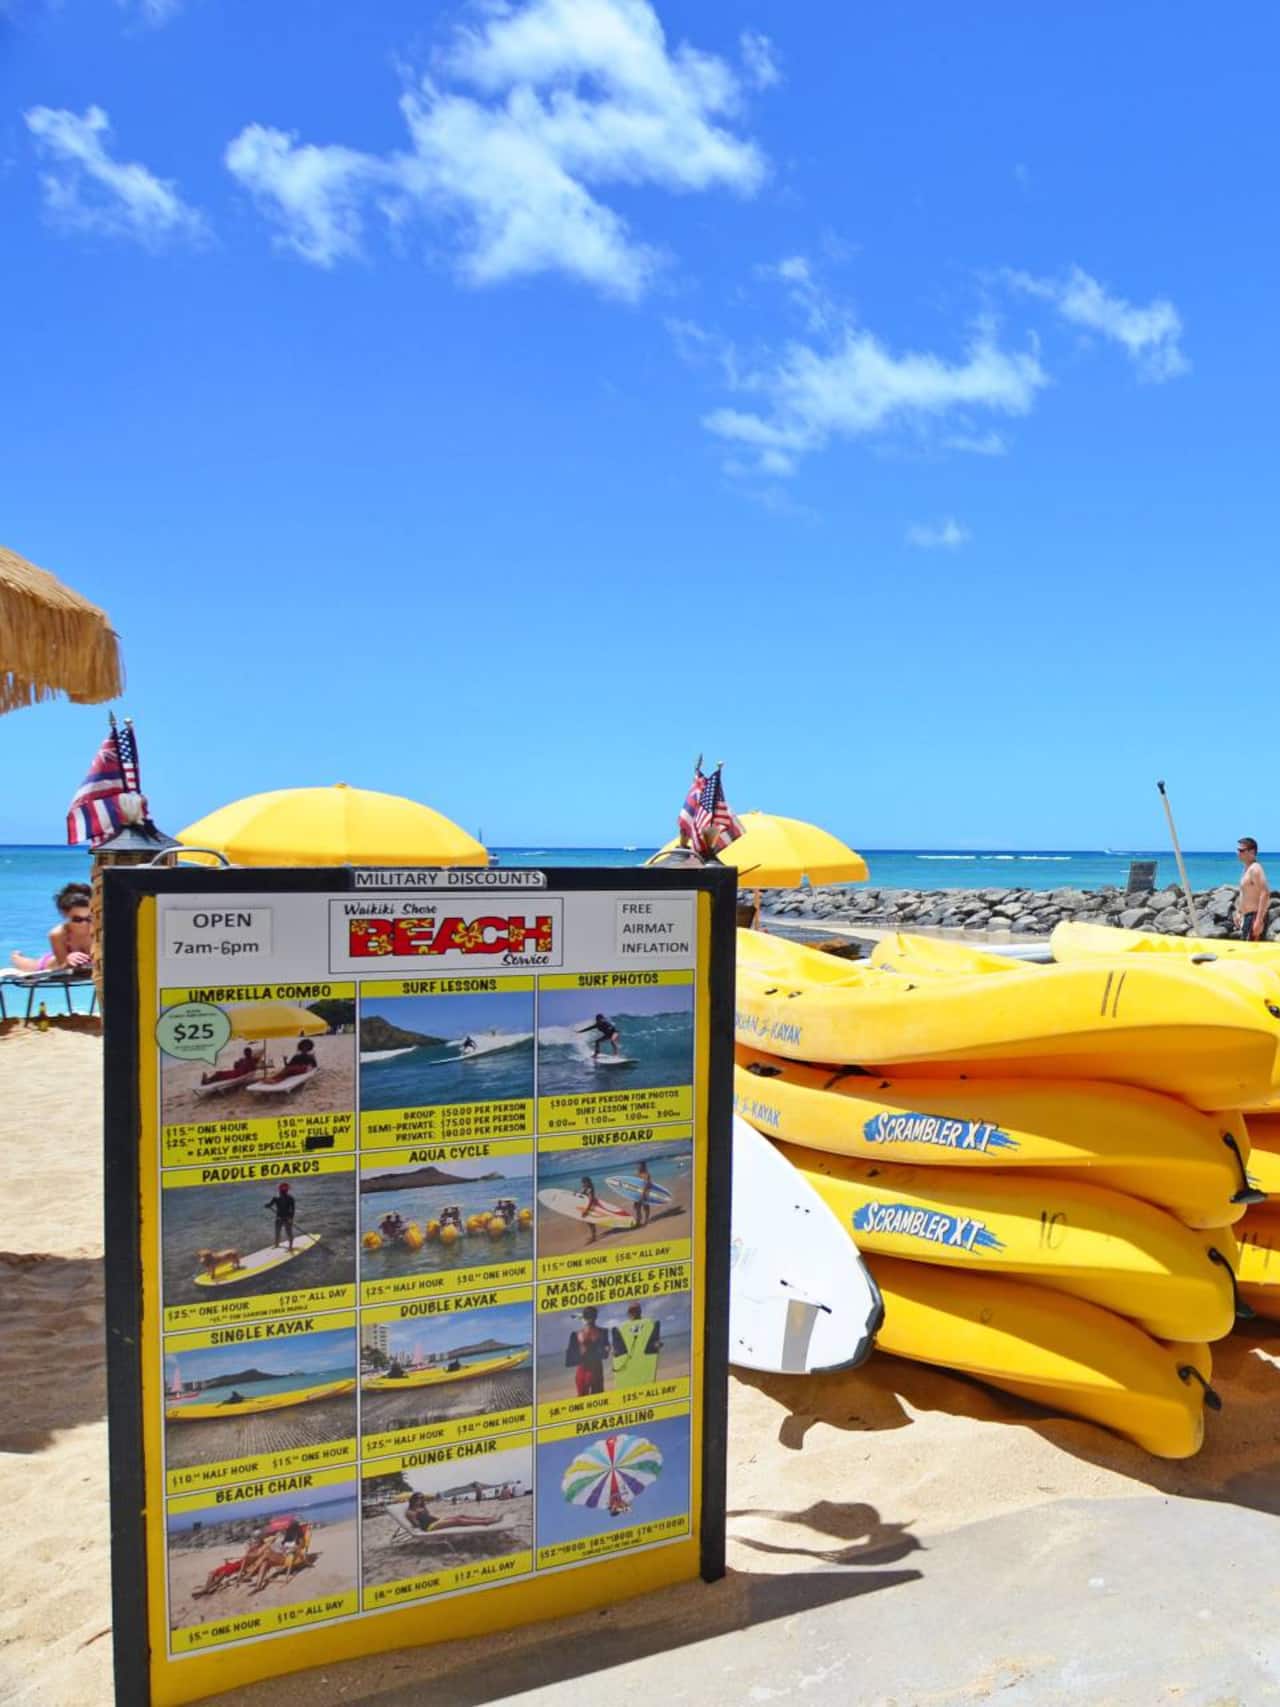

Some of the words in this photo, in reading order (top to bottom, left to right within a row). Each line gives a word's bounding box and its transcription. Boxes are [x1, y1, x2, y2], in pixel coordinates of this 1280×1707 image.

[356, 872, 438, 885] MILITARY
[448, 871, 541, 885] DISCOUNTS
[344, 902, 395, 915] Waikiki
[402, 902, 438, 915] Shore
[622, 903, 653, 914] FREE
[192, 912, 252, 929] OPEN
[622, 922, 675, 934] AIRMAT
[349, 915, 553, 958] BEACH
[172, 940, 259, 956] 7am-6pm
[621, 941, 689, 953] INFLATION
[501, 953, 550, 966] Service
[402, 981, 438, 994] SURF
[440, 979, 497, 993] LESSONS
[578, 974, 609, 987] SURF
[612, 973, 659, 985] PHOTOS
[188, 988, 272, 1003] UMBRELLA
[276, 984, 331, 999] COMBO
[1100, 969, 1127, 1019] 11
[173, 1021, 214, 1043] $25
[474, 1105, 490, 1114] PER
[492, 1103, 527, 1113] PERSON
[306, 1116, 331, 1126] HALF
[333, 1114, 352, 1124] DAY
[473, 1115, 490, 1125] PER
[492, 1113, 526, 1123] PERSON
[197, 1124, 218, 1134] ONE
[220, 1122, 249, 1132] HOUR
[333, 1125, 351, 1135] DAY
[474, 1125, 490, 1135] PER
[492, 1123, 526, 1133] PERSON
[198, 1136, 224, 1146] TWO
[226, 1132, 258, 1144] HOURS
[581, 1129, 654, 1147] SURFBOARD
[197, 1146, 230, 1158] EARLY
[258, 1140, 297, 1152] SPECIAL
[409, 1148, 446, 1163] AQUA
[450, 1144, 490, 1159] CYCLE
[202, 1165, 256, 1183] PADDLE
[261, 1160, 320, 1177] BOARDS
[1039, 1209, 1068, 1250] 10
[483, 1270, 500, 1280] ONE
[591, 1271, 644, 1289] SNORKEL
[658, 1265, 684, 1279] FINS
[393, 1280, 416, 1292] HALF
[419, 1277, 444, 1289] HOUR
[307, 1291, 326, 1301] ALL
[328, 1288, 347, 1298] DAY
[541, 1297, 558, 1311] OR
[561, 1290, 607, 1307] BOOGIE
[609, 1283, 649, 1299] BOARD
[664, 1278, 689, 1291] FINS
[199, 1305, 218, 1316] ONE
[221, 1301, 250, 1313] HOUR
[400, 1299, 450, 1318] DOUBLE
[454, 1293, 498, 1310] KAYAK
[210, 1325, 262, 1345] SINGLE
[266, 1319, 315, 1338] KAYAK
[575, 1409, 655, 1434] PARASAILING
[394, 1433, 417, 1446] HALF
[419, 1429, 445, 1441] HOUR
[301, 1450, 321, 1462] ONE
[322, 1446, 350, 1458] HOUR
[401, 1447, 454, 1469] LOUNGE
[456, 1440, 497, 1458] CHAIR
[202, 1467, 228, 1481] HALF
[231, 1462, 259, 1475] HOUR
[215, 1483, 264, 1504] BEACH
[268, 1475, 313, 1494] CHAIR
[305, 1605, 323, 1617] ALL
[211, 1625, 231, 1637] ONE
[233, 1618, 262, 1632] HOUR
